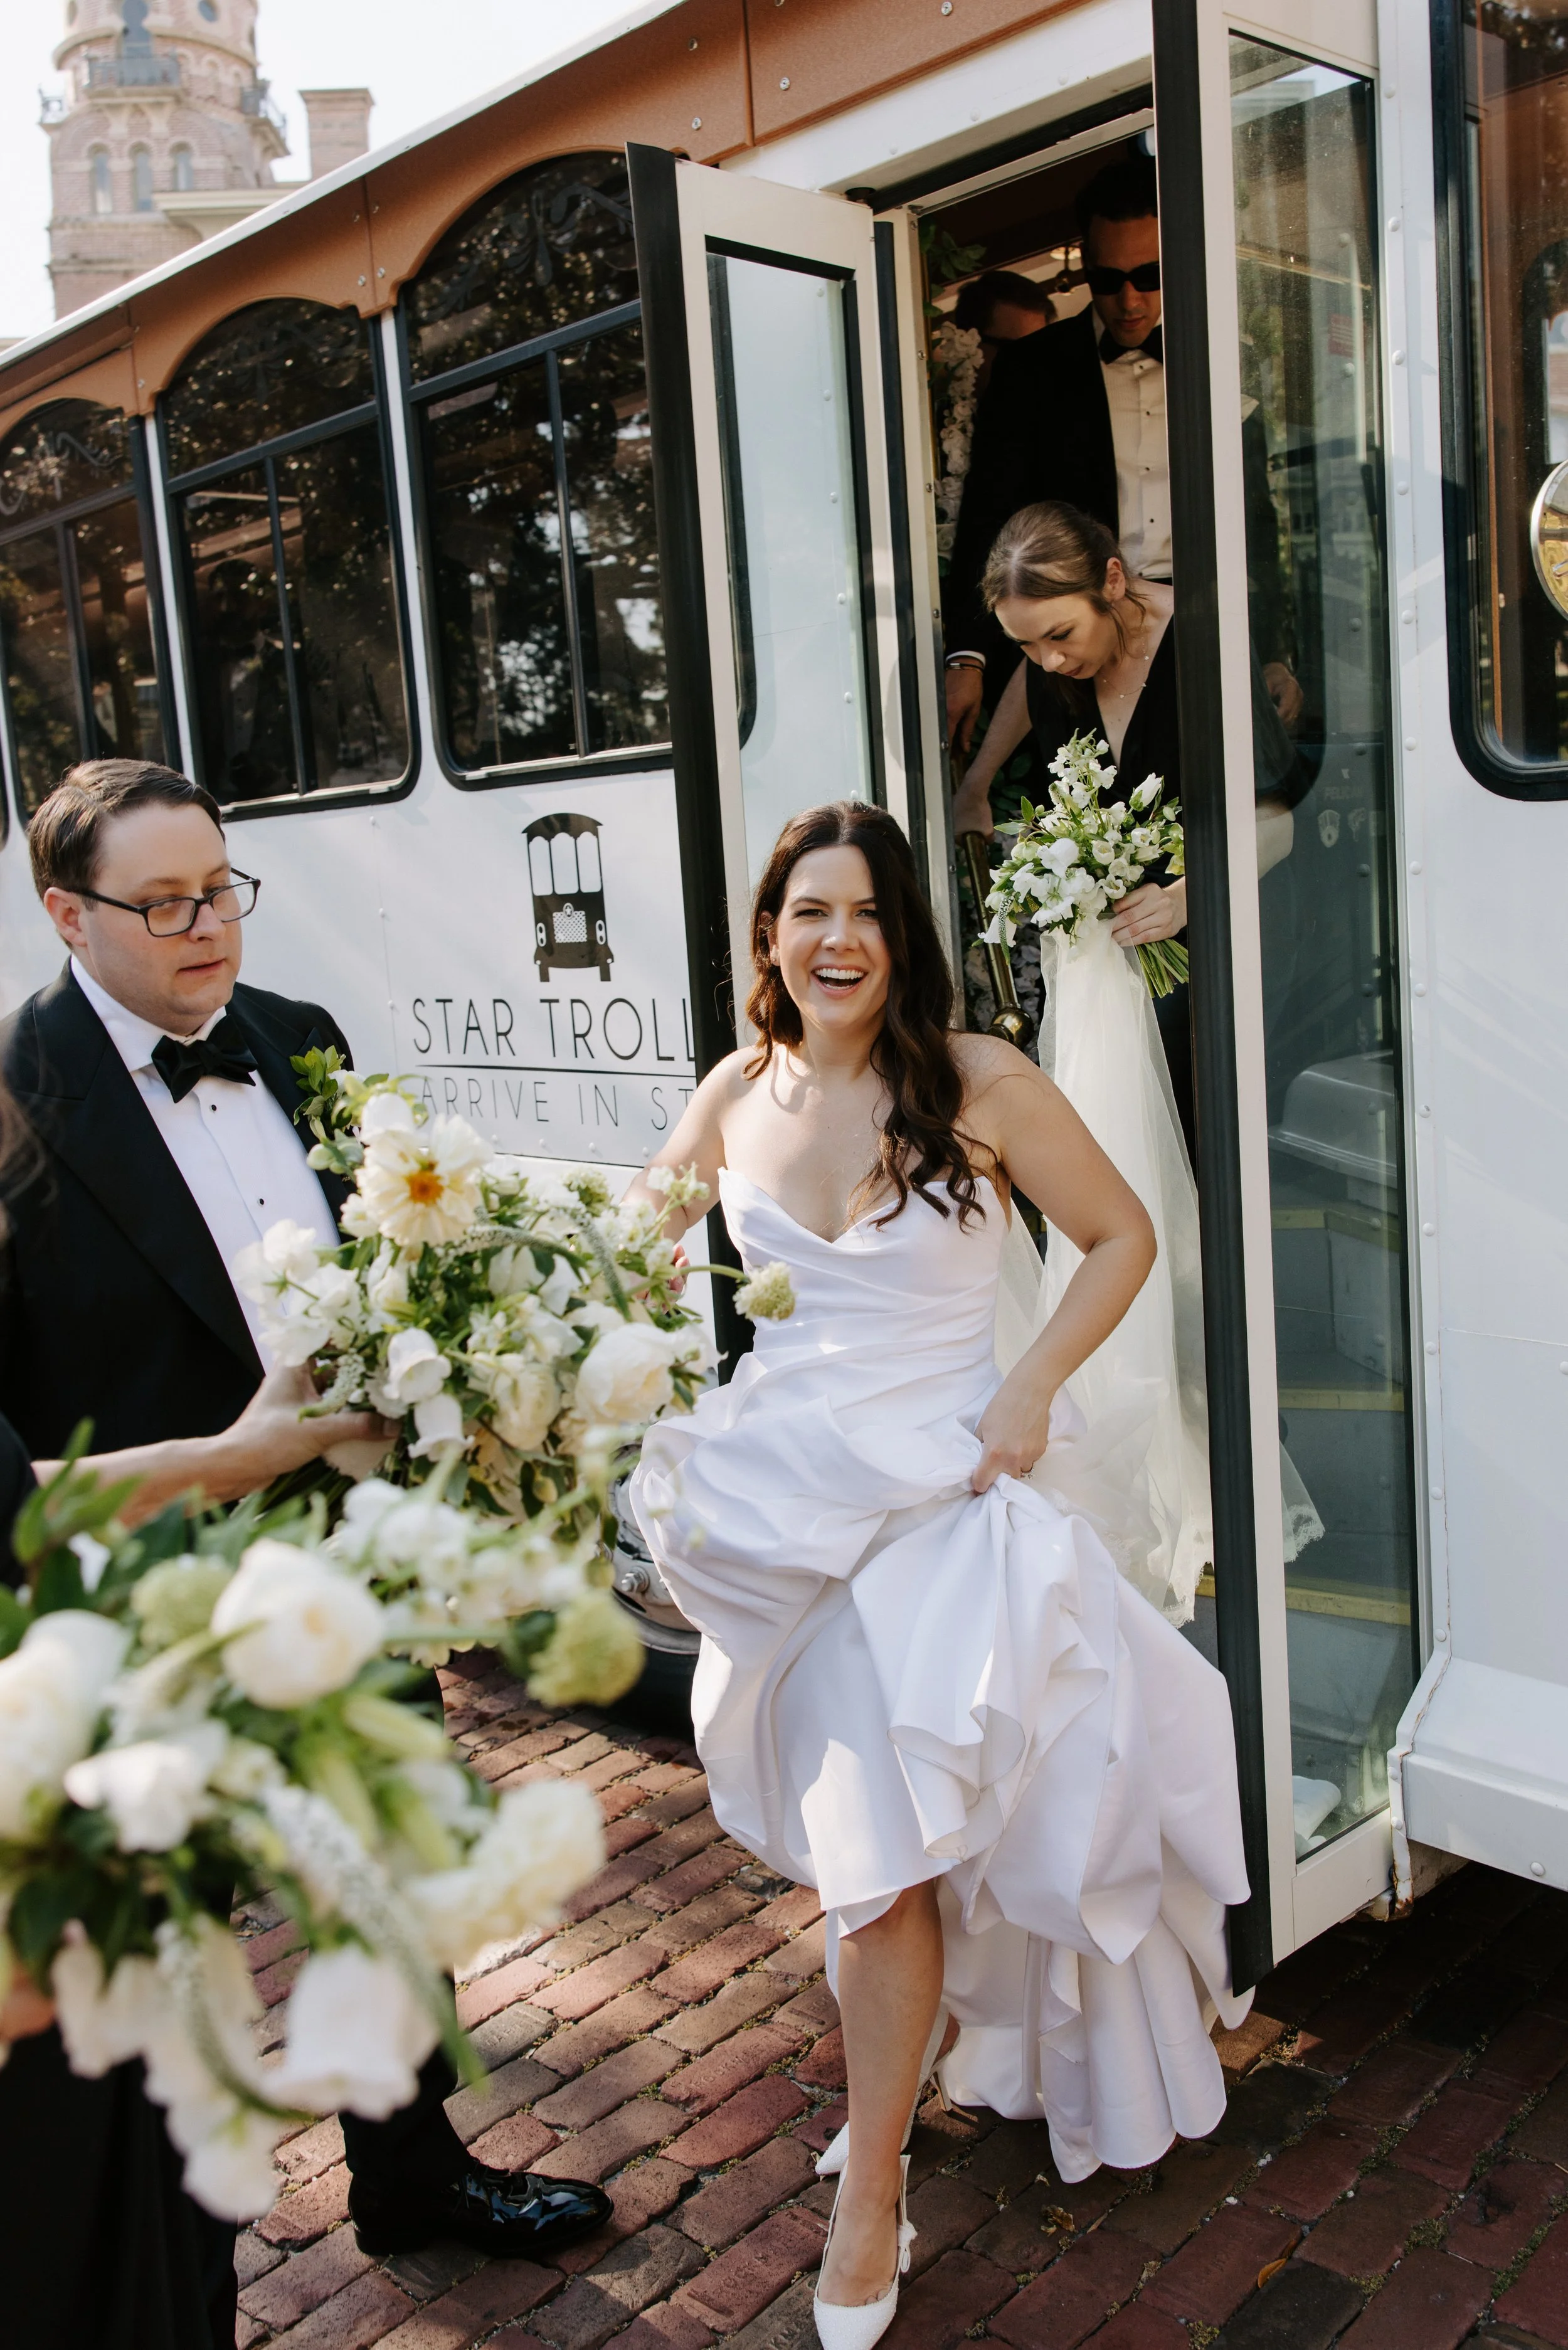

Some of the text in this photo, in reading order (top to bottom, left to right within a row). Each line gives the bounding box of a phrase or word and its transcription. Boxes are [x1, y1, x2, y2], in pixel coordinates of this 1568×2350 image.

[412, 998, 694, 1062] STAR TROLL
[421, 1076, 549, 1122] ARRIVE
[578, 1084, 619, 1128] IN
